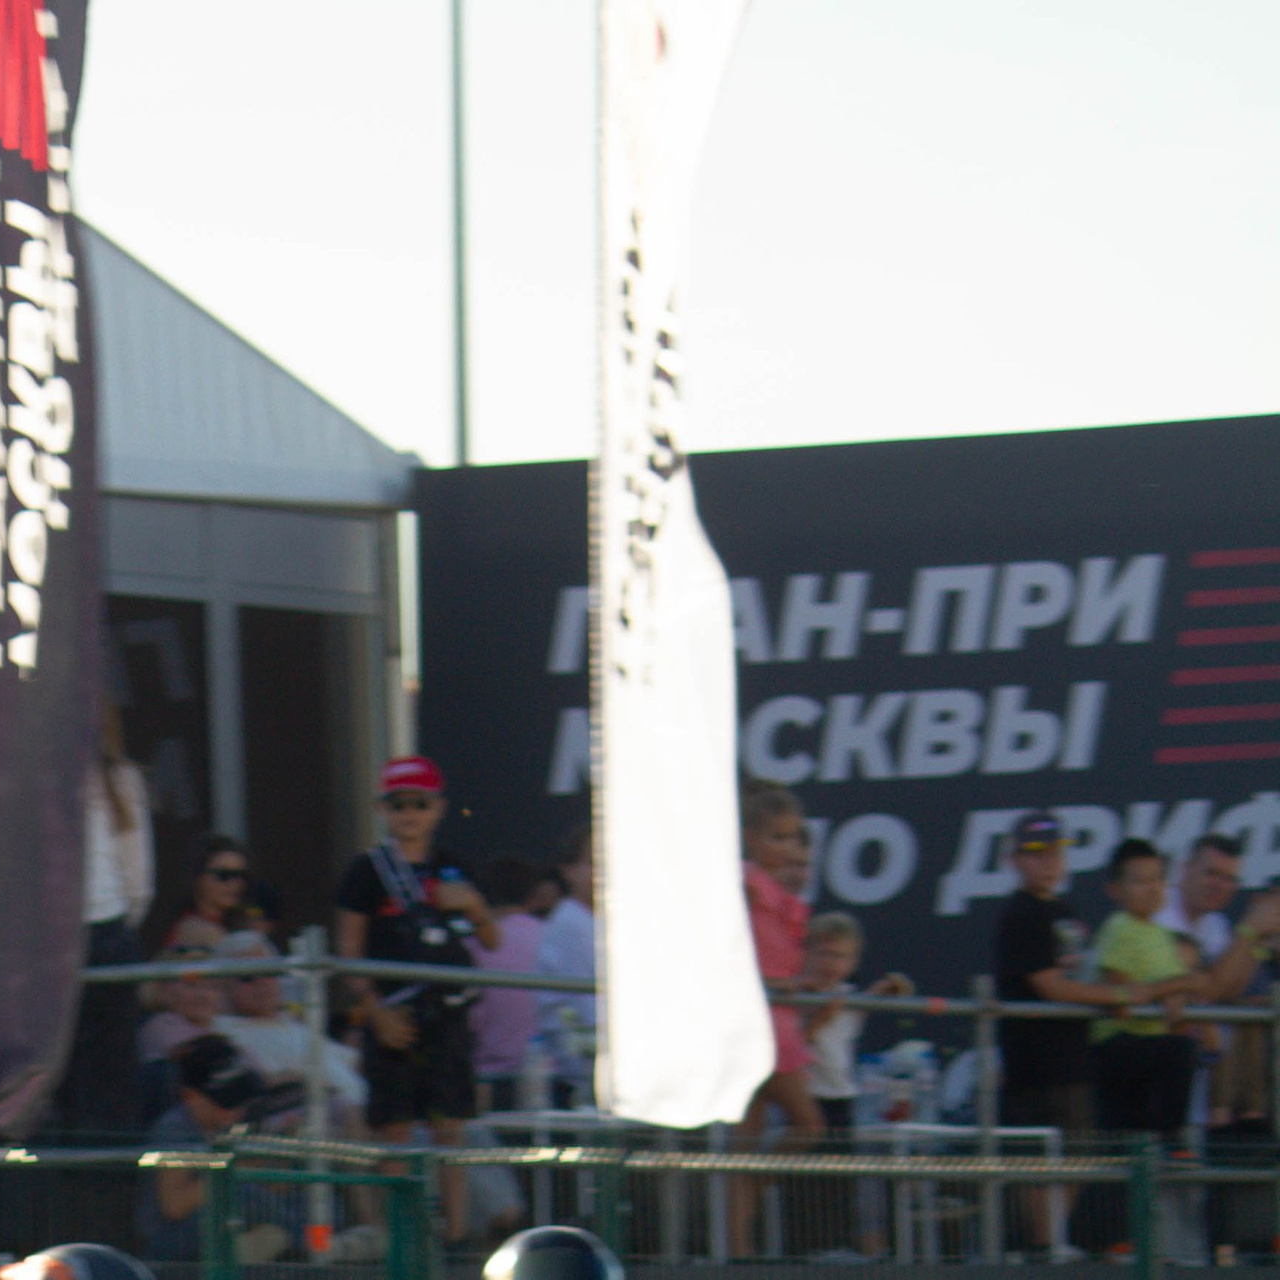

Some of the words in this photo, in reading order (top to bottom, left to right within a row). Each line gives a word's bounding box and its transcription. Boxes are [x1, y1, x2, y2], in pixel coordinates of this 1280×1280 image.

[546, 552, 1168, 675] ГАН-ПРИ
[547, 680, 1109, 796] СКВЫ
[805, 810, 919, 907] О
